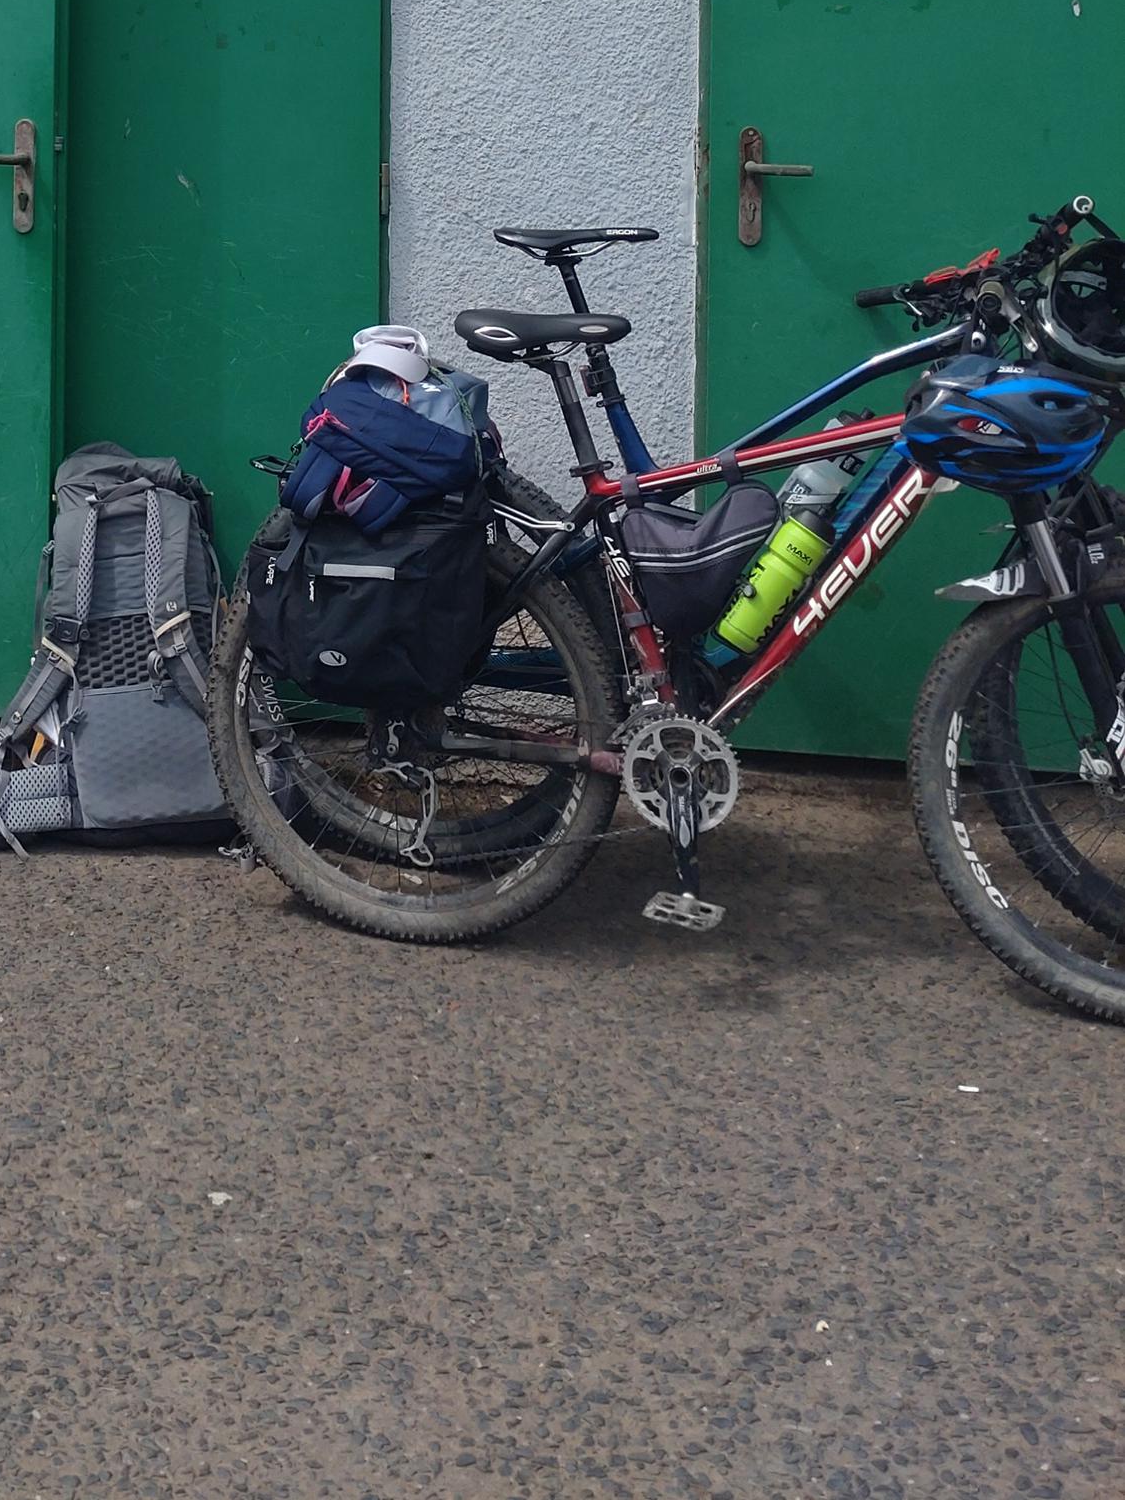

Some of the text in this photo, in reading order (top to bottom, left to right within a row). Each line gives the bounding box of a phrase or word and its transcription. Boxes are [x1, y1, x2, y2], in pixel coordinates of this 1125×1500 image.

[793, 467, 931, 638] 4EVER
[236, 646, 254, 707] ISC
[260, 675, 284, 722] SWISS
[952, 820, 1010, 910] DISC
